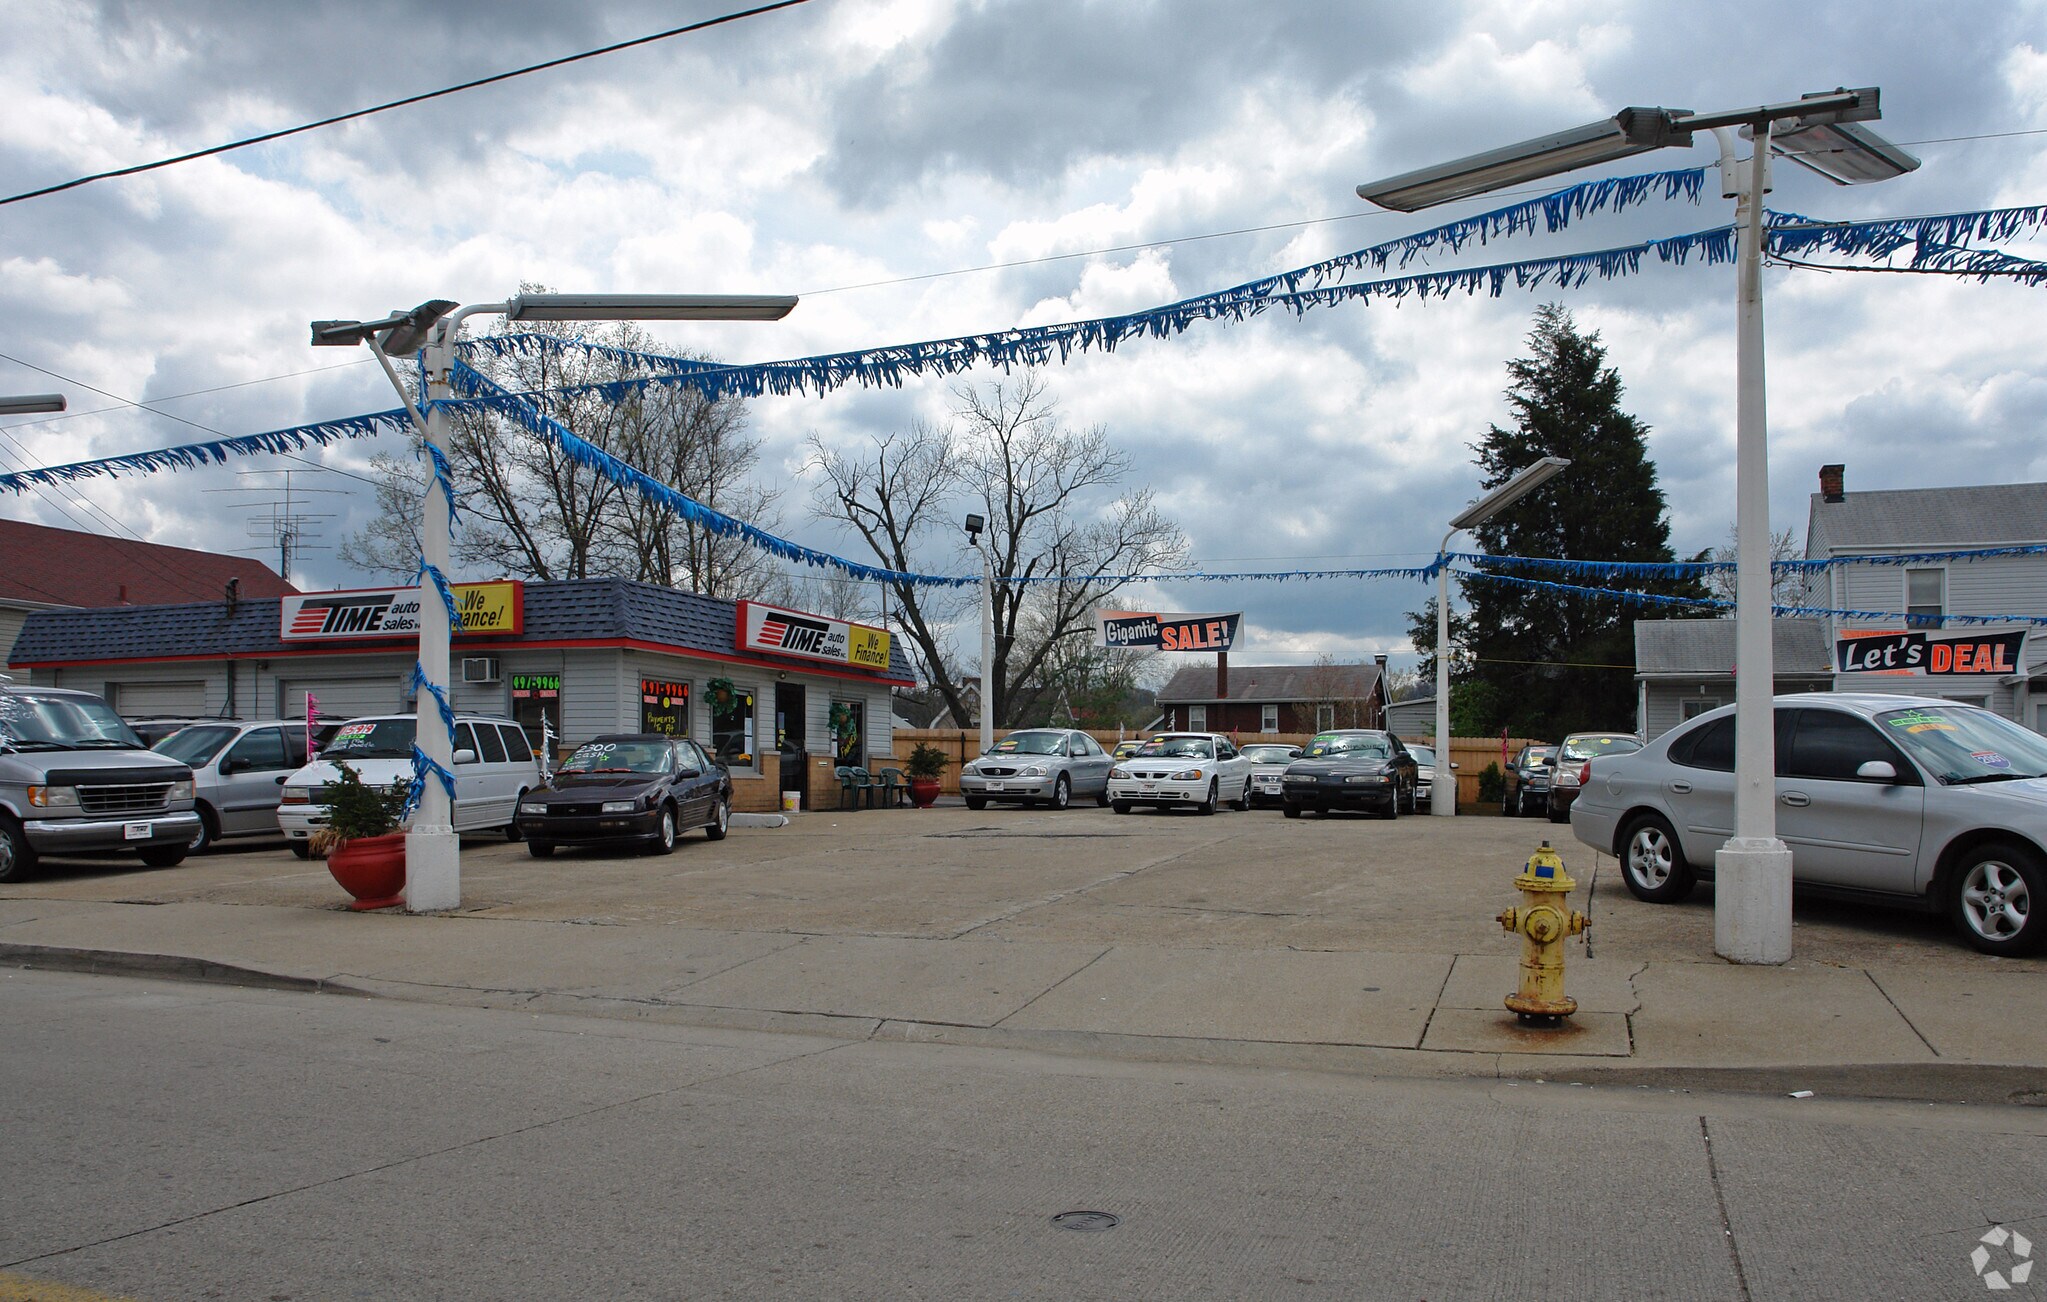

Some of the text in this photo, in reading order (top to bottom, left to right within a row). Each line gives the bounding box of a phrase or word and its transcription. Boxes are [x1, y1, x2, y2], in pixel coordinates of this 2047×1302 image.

[391, 600, 420, 615] auto
[464, 590, 485, 610] We
[301, 595, 395, 633] TIME
[382, 616, 414, 630] sales
[766, 612, 829, 654] TIME
[828, 632, 845, 643] auto
[867, 633, 879, 650] We
[1106, 620, 1230, 650] Gigantic SALE!
[821, 644, 842, 657] sales
[855, 644, 888, 664] Finance!
[1845, 638, 2013, 673] Let's DEAL
[642, 680, 689, 697] 491-9966
[576, 743, 616, 753] 2300
